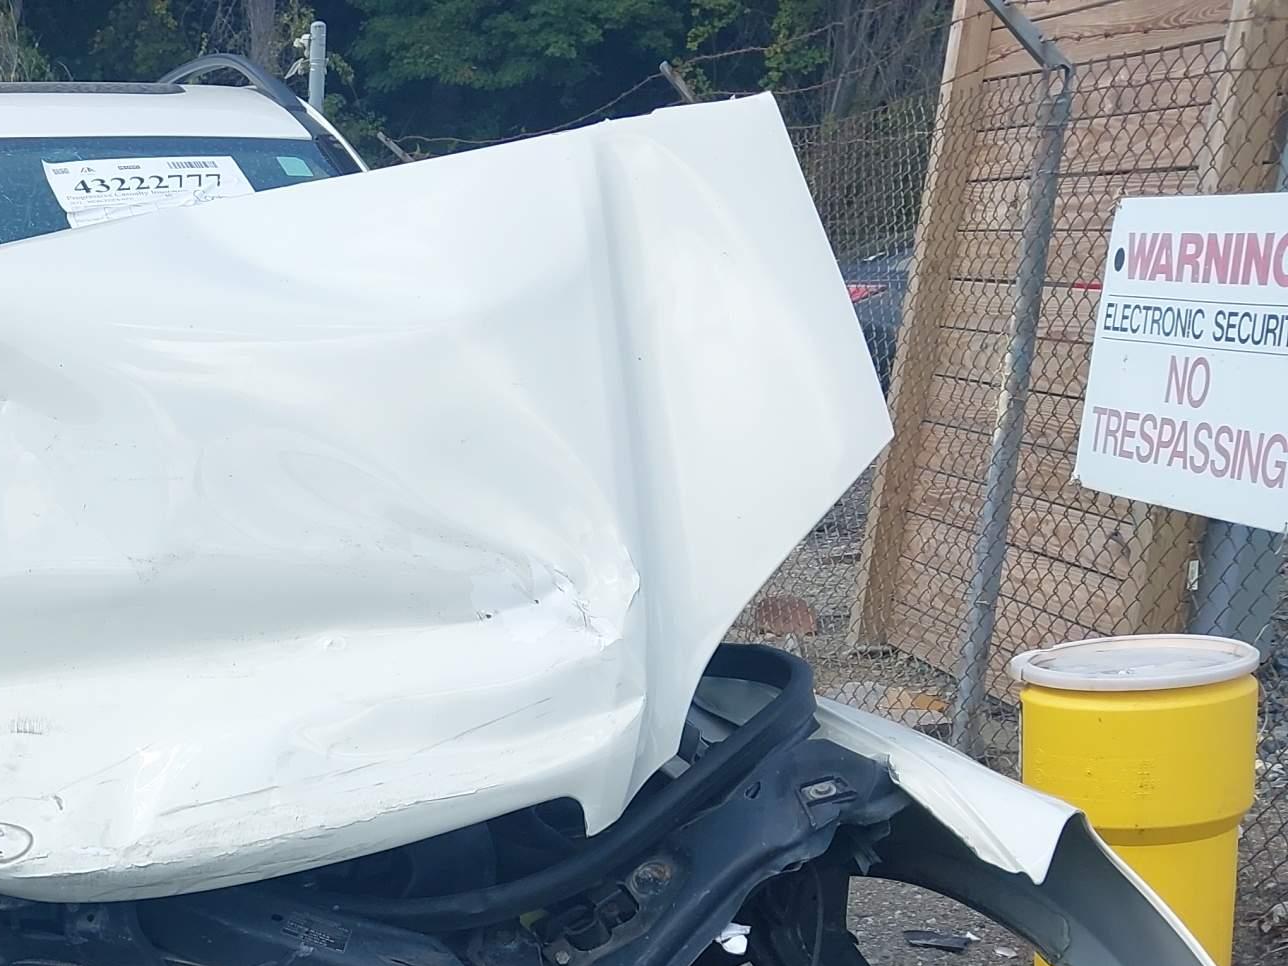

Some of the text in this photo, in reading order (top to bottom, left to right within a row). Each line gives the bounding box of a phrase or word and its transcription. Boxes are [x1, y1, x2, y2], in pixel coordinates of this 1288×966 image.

[74, 173, 221, 194] 43222777
[1104, 303, 1288, 348] ELECTRONIC SECURI
[1164, 355, 1211, 408] NO
[1092, 406, 1288, 489] TRESPASSING
